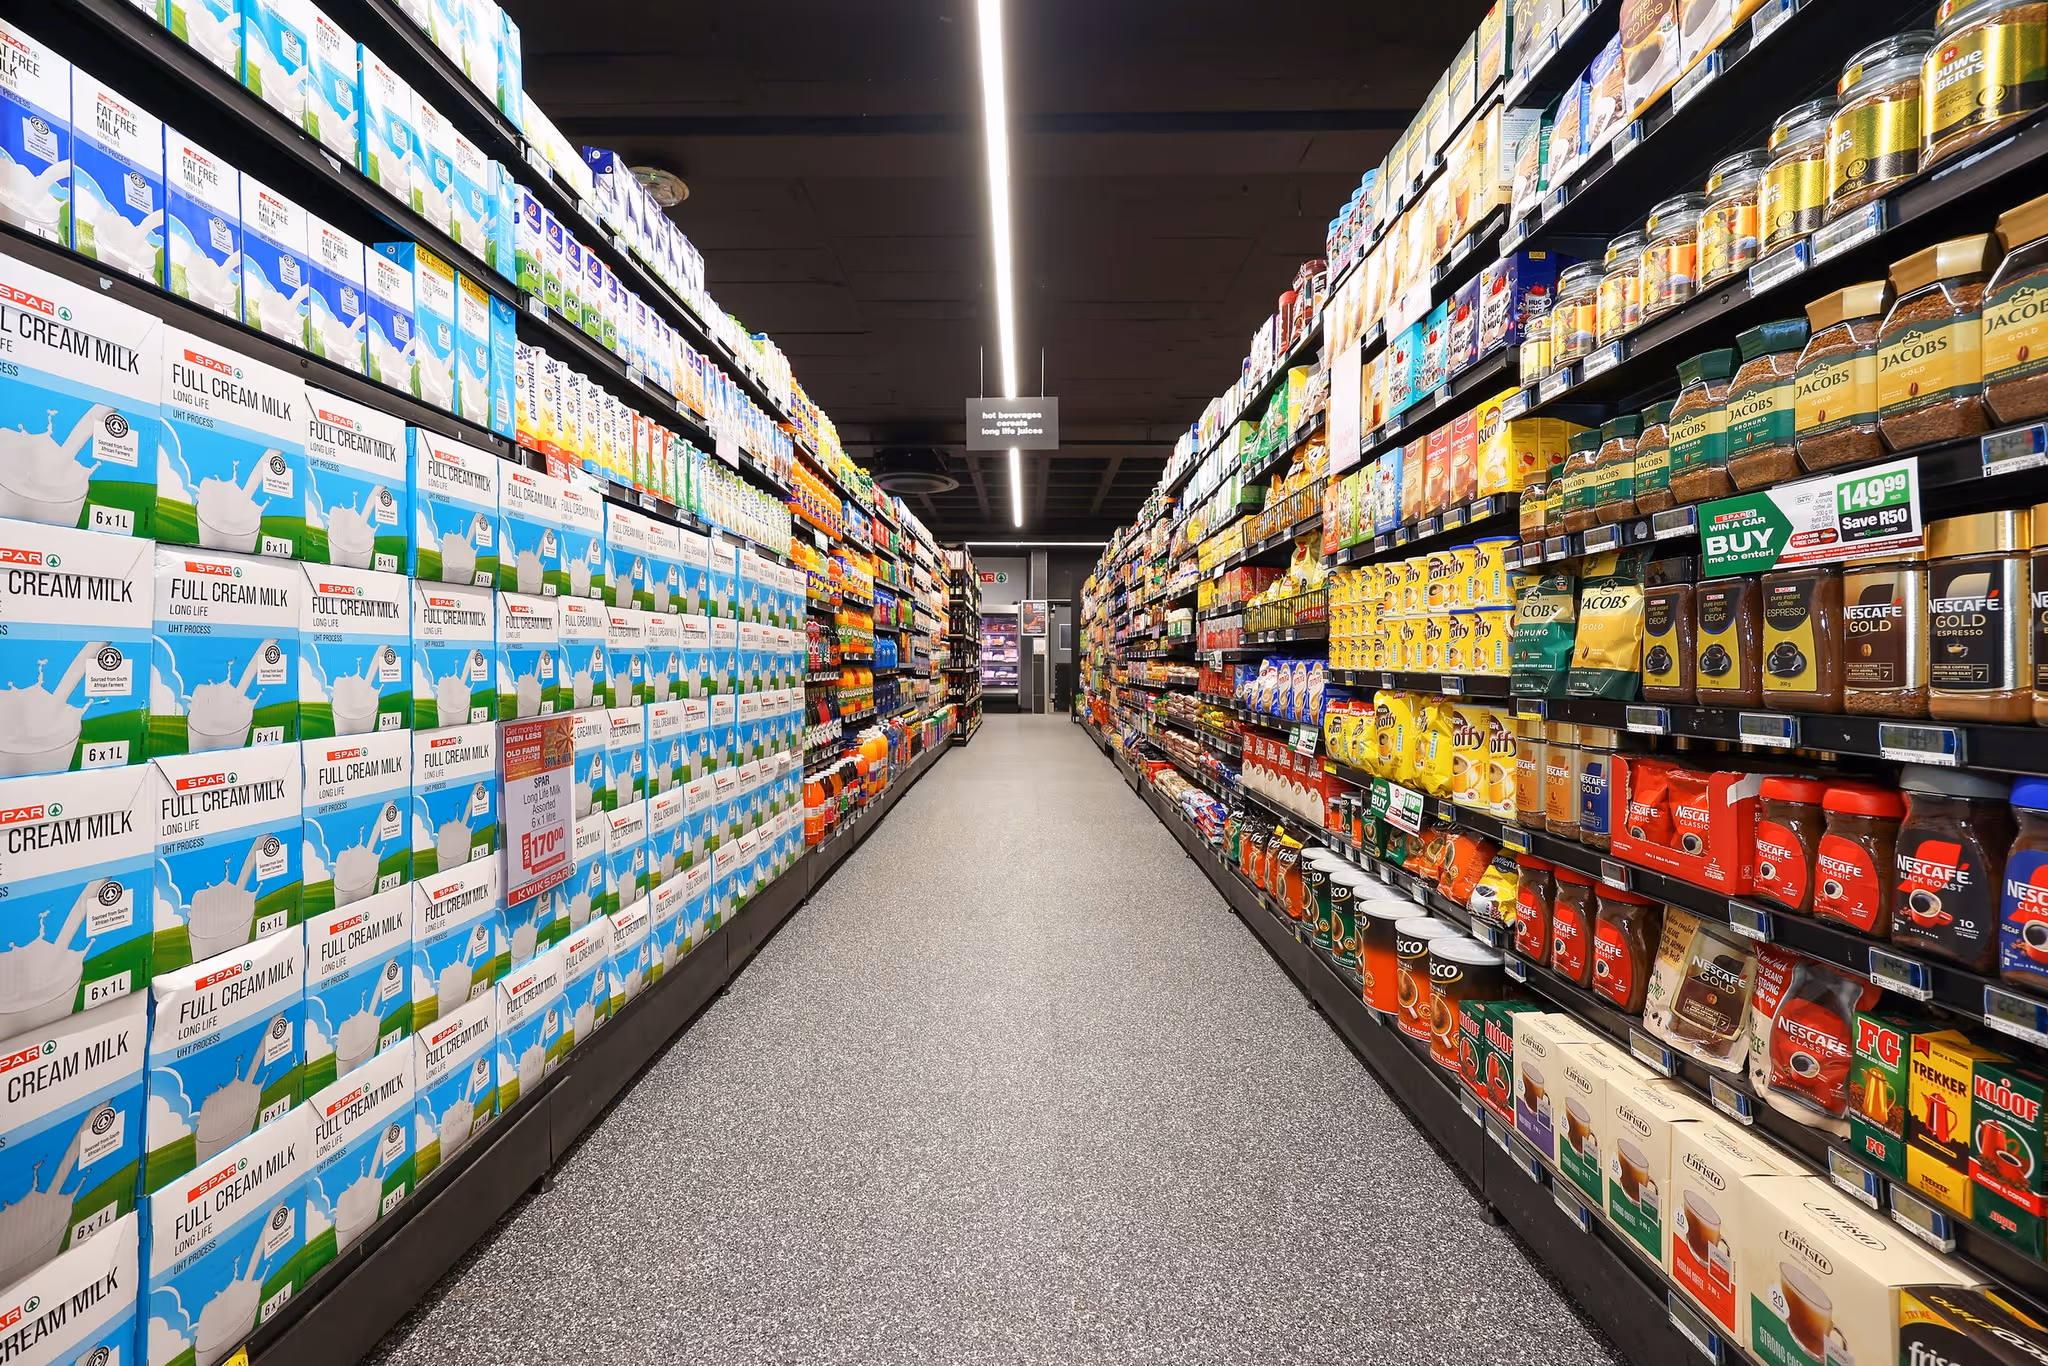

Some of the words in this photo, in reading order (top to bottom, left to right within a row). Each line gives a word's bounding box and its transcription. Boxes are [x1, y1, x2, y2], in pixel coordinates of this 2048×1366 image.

[1626, 2, 1664, 39] coffee
[12, 50, 40, 77] FREE
[3, 89, 30, 109] PROCESS
[96, 102, 113, 120] FAT
[115, 111, 138, 137] FREE
[96, 116, 120, 140] MILK
[183, 156, 196, 173] FAT
[198, 166, 218, 186] FREE
[184, 171, 204, 190] MILK
[0, 284, 54, 314] SPAR
[19, 313, 89, 358] CREAM
[96, 340, 139, 375] MILK
[2008, 328, 2038, 342] GOLD
[1880, 336, 1948, 372] JACOBS
[196, 355, 232, 375] SPAR
[1900, 366, 1925, 378] GOLD
[173, 364, 208, 395] FULL
[212, 377, 258, 411] CREAM
[262, 397, 292, 421] MILK
[1796, 369, 1850, 400] JACOBS
[173, 390, 193, 406] LONG
[194, 397, 209, 410] LIFE
[1728, 397, 1773, 422] JACOBS
[1812, 395, 1832, 406] GOLD
[173, 409, 185, 420] UHT
[187, 413, 213, 428] PROCESS
[327, 413, 353, 428] SPAR
[998, 412, 1042, 420] beverages
[310, 421, 336, 444] FULL
[338, 430, 371, 454] CREAM
[374, 439, 396, 462] MILK
[982, 428, 1000, 436] long
[1670, 421, 1706, 444] JACOBS
[1636, 457, 1662, 471] JACOBS
[1709, 522, 1730, 532] WIN
[1732, 520, 1740, 528] A
[1742, 516, 1766, 526] CAR
[1722, 512, 1746, 521] SPAR
[1842, 515, 1878, 529] Save
[1879, 508, 1907, 525] R50
[1706, 528, 1774, 556] BUY
[1708, 555, 1725, 564] me
[1727, 553, 1738, 562] to
[1741, 549, 1774, 560] enter!
[196, 563, 232, 575] SPAR
[9, 570, 81, 598] CREAM
[88, 578, 132, 602] MILK
[171, 578, 207, 601] FULL
[212, 583, 257, 605] CREAM
[260, 589, 288, 607] MILK
[169, 604, 191, 616] LONG
[193, 606, 208, 617] LIFE
[1704, 613, 1726, 622] DECAF
[1767, 608, 1805, 617] ESPRESSO
[1649, 617, 1668, 625] DECAF
[1850, 620, 1891, 633] GOLD
[1936, 614, 1986, 628] GOLD
[1976, 671, 1983, 679] 7
[506, 735, 523, 743] EVEN
[525, 732, 542, 740] LESS
[424, 752, 444, 769] FULL
[445, 748, 470, 765] CREAM
[472, 745, 489, 758] MILK
[506, 749, 521, 758] OLD
[522, 746, 540, 754] FARM
[188, 774, 225, 788] SPAR
[319, 767, 344, 786] FULL
[346, 760, 378, 779] CREAM
[381, 756, 402, 772] MILK
[534, 775, 550, 788] SPAR
[1582, 784, 1601, 795] GOLD
[162, 796, 198, 820] FULL
[202, 786, 250, 812] CREAM
[254, 780, 285, 802] MILK
[523, 794, 537, 805] Long
[539, 789, 549, 799] Life
[550, 786, 561, 795] Milk
[1372, 794, 1387, 809] BUY
[532, 799, 556, 815] Assorted
[532, 819, 536, 828] 6
[546, 812, 556, 822] litre
[9, 819, 81, 854] CREAM
[88, 810, 132, 840] MILK
[162, 844, 175, 854] UHT
[177, 838, 205, 852] PROCESS
[1759, 852, 1782, 862] CLASSIC
[1822, 867, 1850, 880] CLASSIC
[1900, 873, 1924, 887] BLACK
[1927, 877, 1964, 892] ROAST
[518, 869, 568, 900] KWIKSPAR
[1959, 919, 1974, 928] 10
[2002, 924, 2019, 935] DECAF
[207, 964, 242, 986] SPAR
[1700, 971, 1736, 995] GOLD
[1764, 969, 1784, 984] BEANS
[180, 992, 218, 1024] FULL
[222, 973, 265, 1007] CREAM
[268, 957, 294, 985] MILK
[1759, 977, 1779, 996] STRONG
[1522, 1034, 1544, 1054] Enrista
[1789, 1035, 1833, 1058] CLASSIC
[1857, 1016, 1901, 1068] FG
[8, 1051, 79, 1103] CREAM
[85, 1031, 128, 1068] MILK
[1565, 1067, 1590, 1090] Enrista
[1913, 1060, 1967, 1098] TREKKER
[334, 1089, 362, 1110] SPAR
[1619, 1105, 1648, 1134] Enrista
[1866, 1136, 1885, 1158] FG
[199, 1164, 236, 1194] SPAR
[1686, 1152, 1722, 1187] Enrista
[175, 1202, 211, 1239] FULL
[215, 1167, 262, 1209] CREAM
[265, 1143, 296, 1174] MILK
[1921, 1174, 1950, 1195] TREKKER
[1977, 1173, 2000, 1191] CHICORY
[2007, 1191, 2031, 1208] COFFEE
[1676, 1212, 1684, 1224] 10
[174, 1232, 196, 1257] LONG
[197, 1224, 212, 1244] LIFE
[1784, 1228, 1829, 1271] Enrista
[1772, 1291, 1784, 1308] 20
[1759, 1326, 1785, 1363] STRONG
